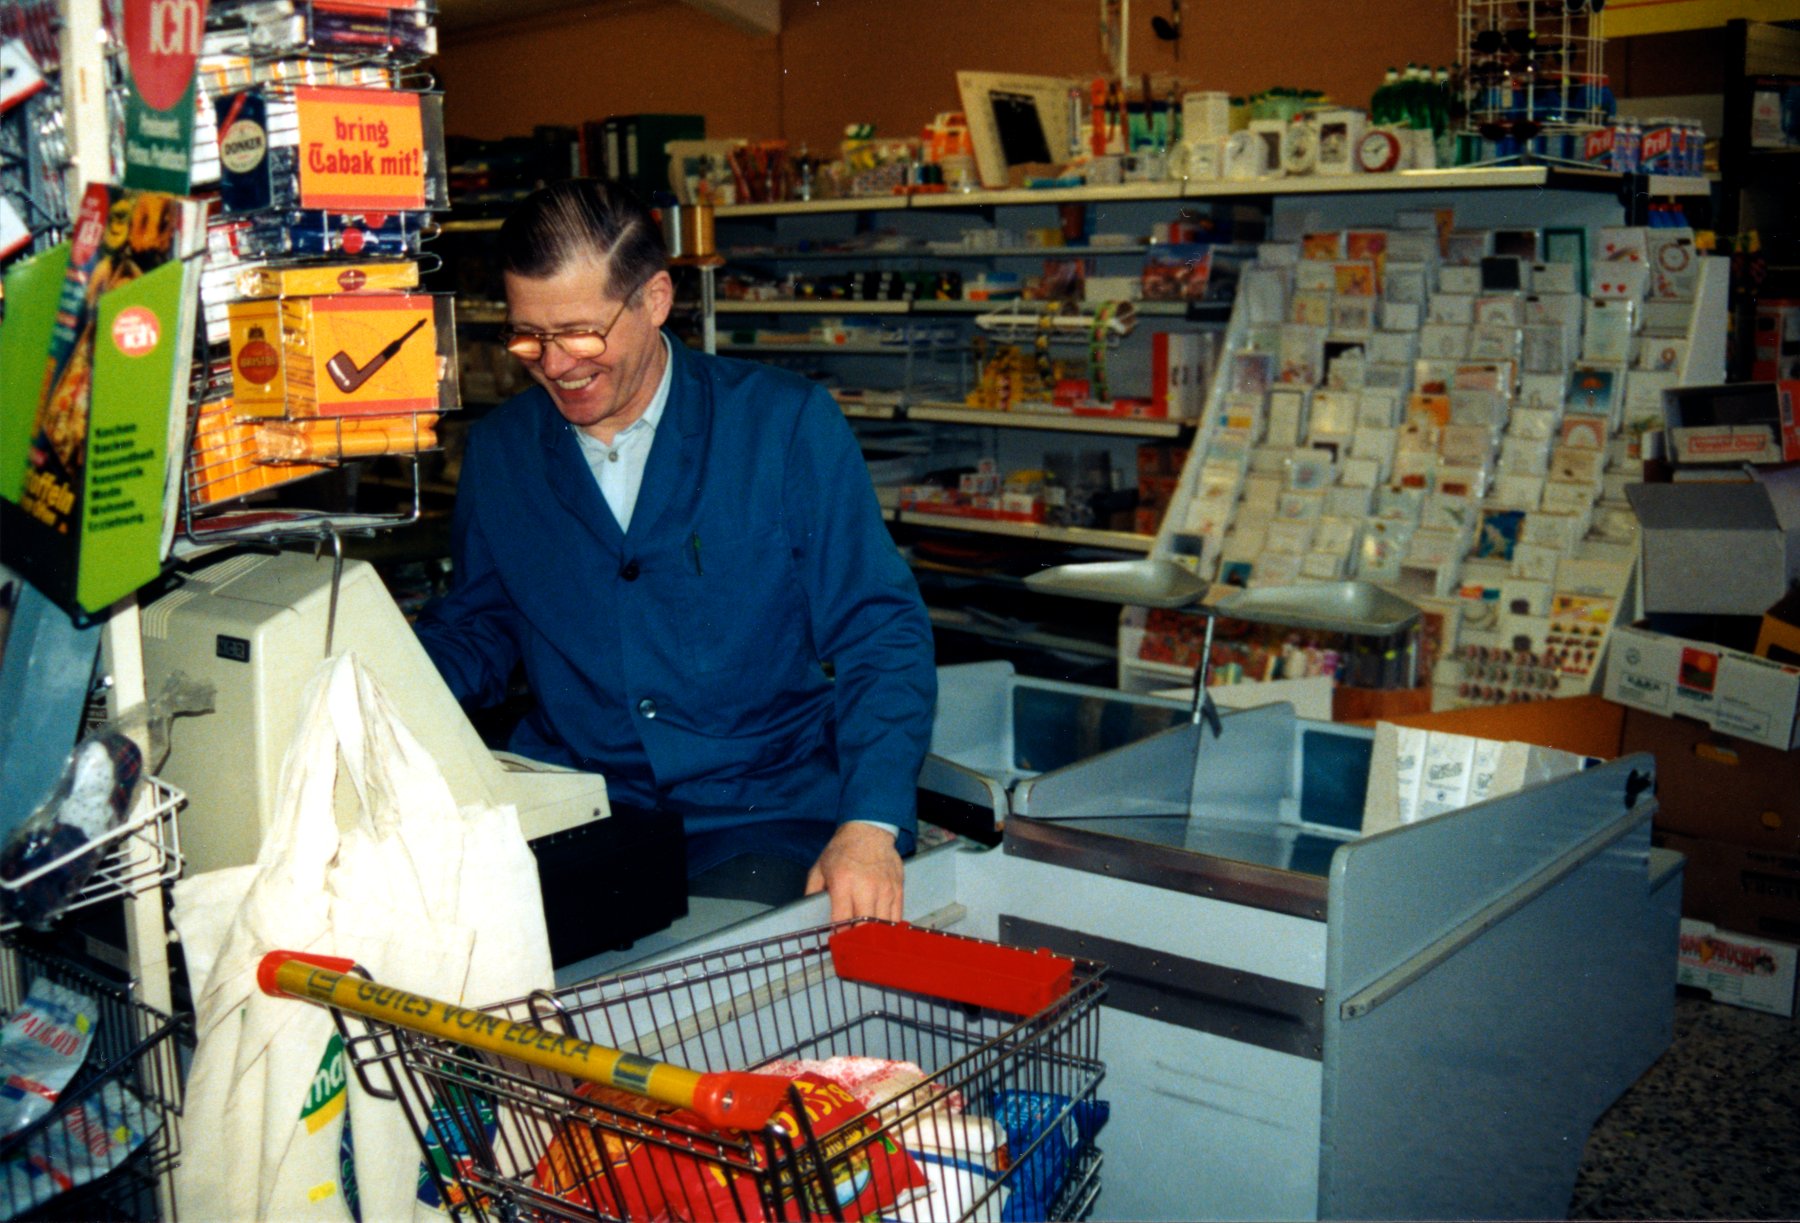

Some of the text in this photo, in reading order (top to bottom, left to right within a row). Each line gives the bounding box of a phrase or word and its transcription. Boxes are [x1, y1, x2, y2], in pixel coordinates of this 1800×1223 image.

[334, 115, 389, 148] bring
[308, 142, 419, 177] Tabak mit!
[357, 980, 594, 1063] GUTES VON EDEKA
